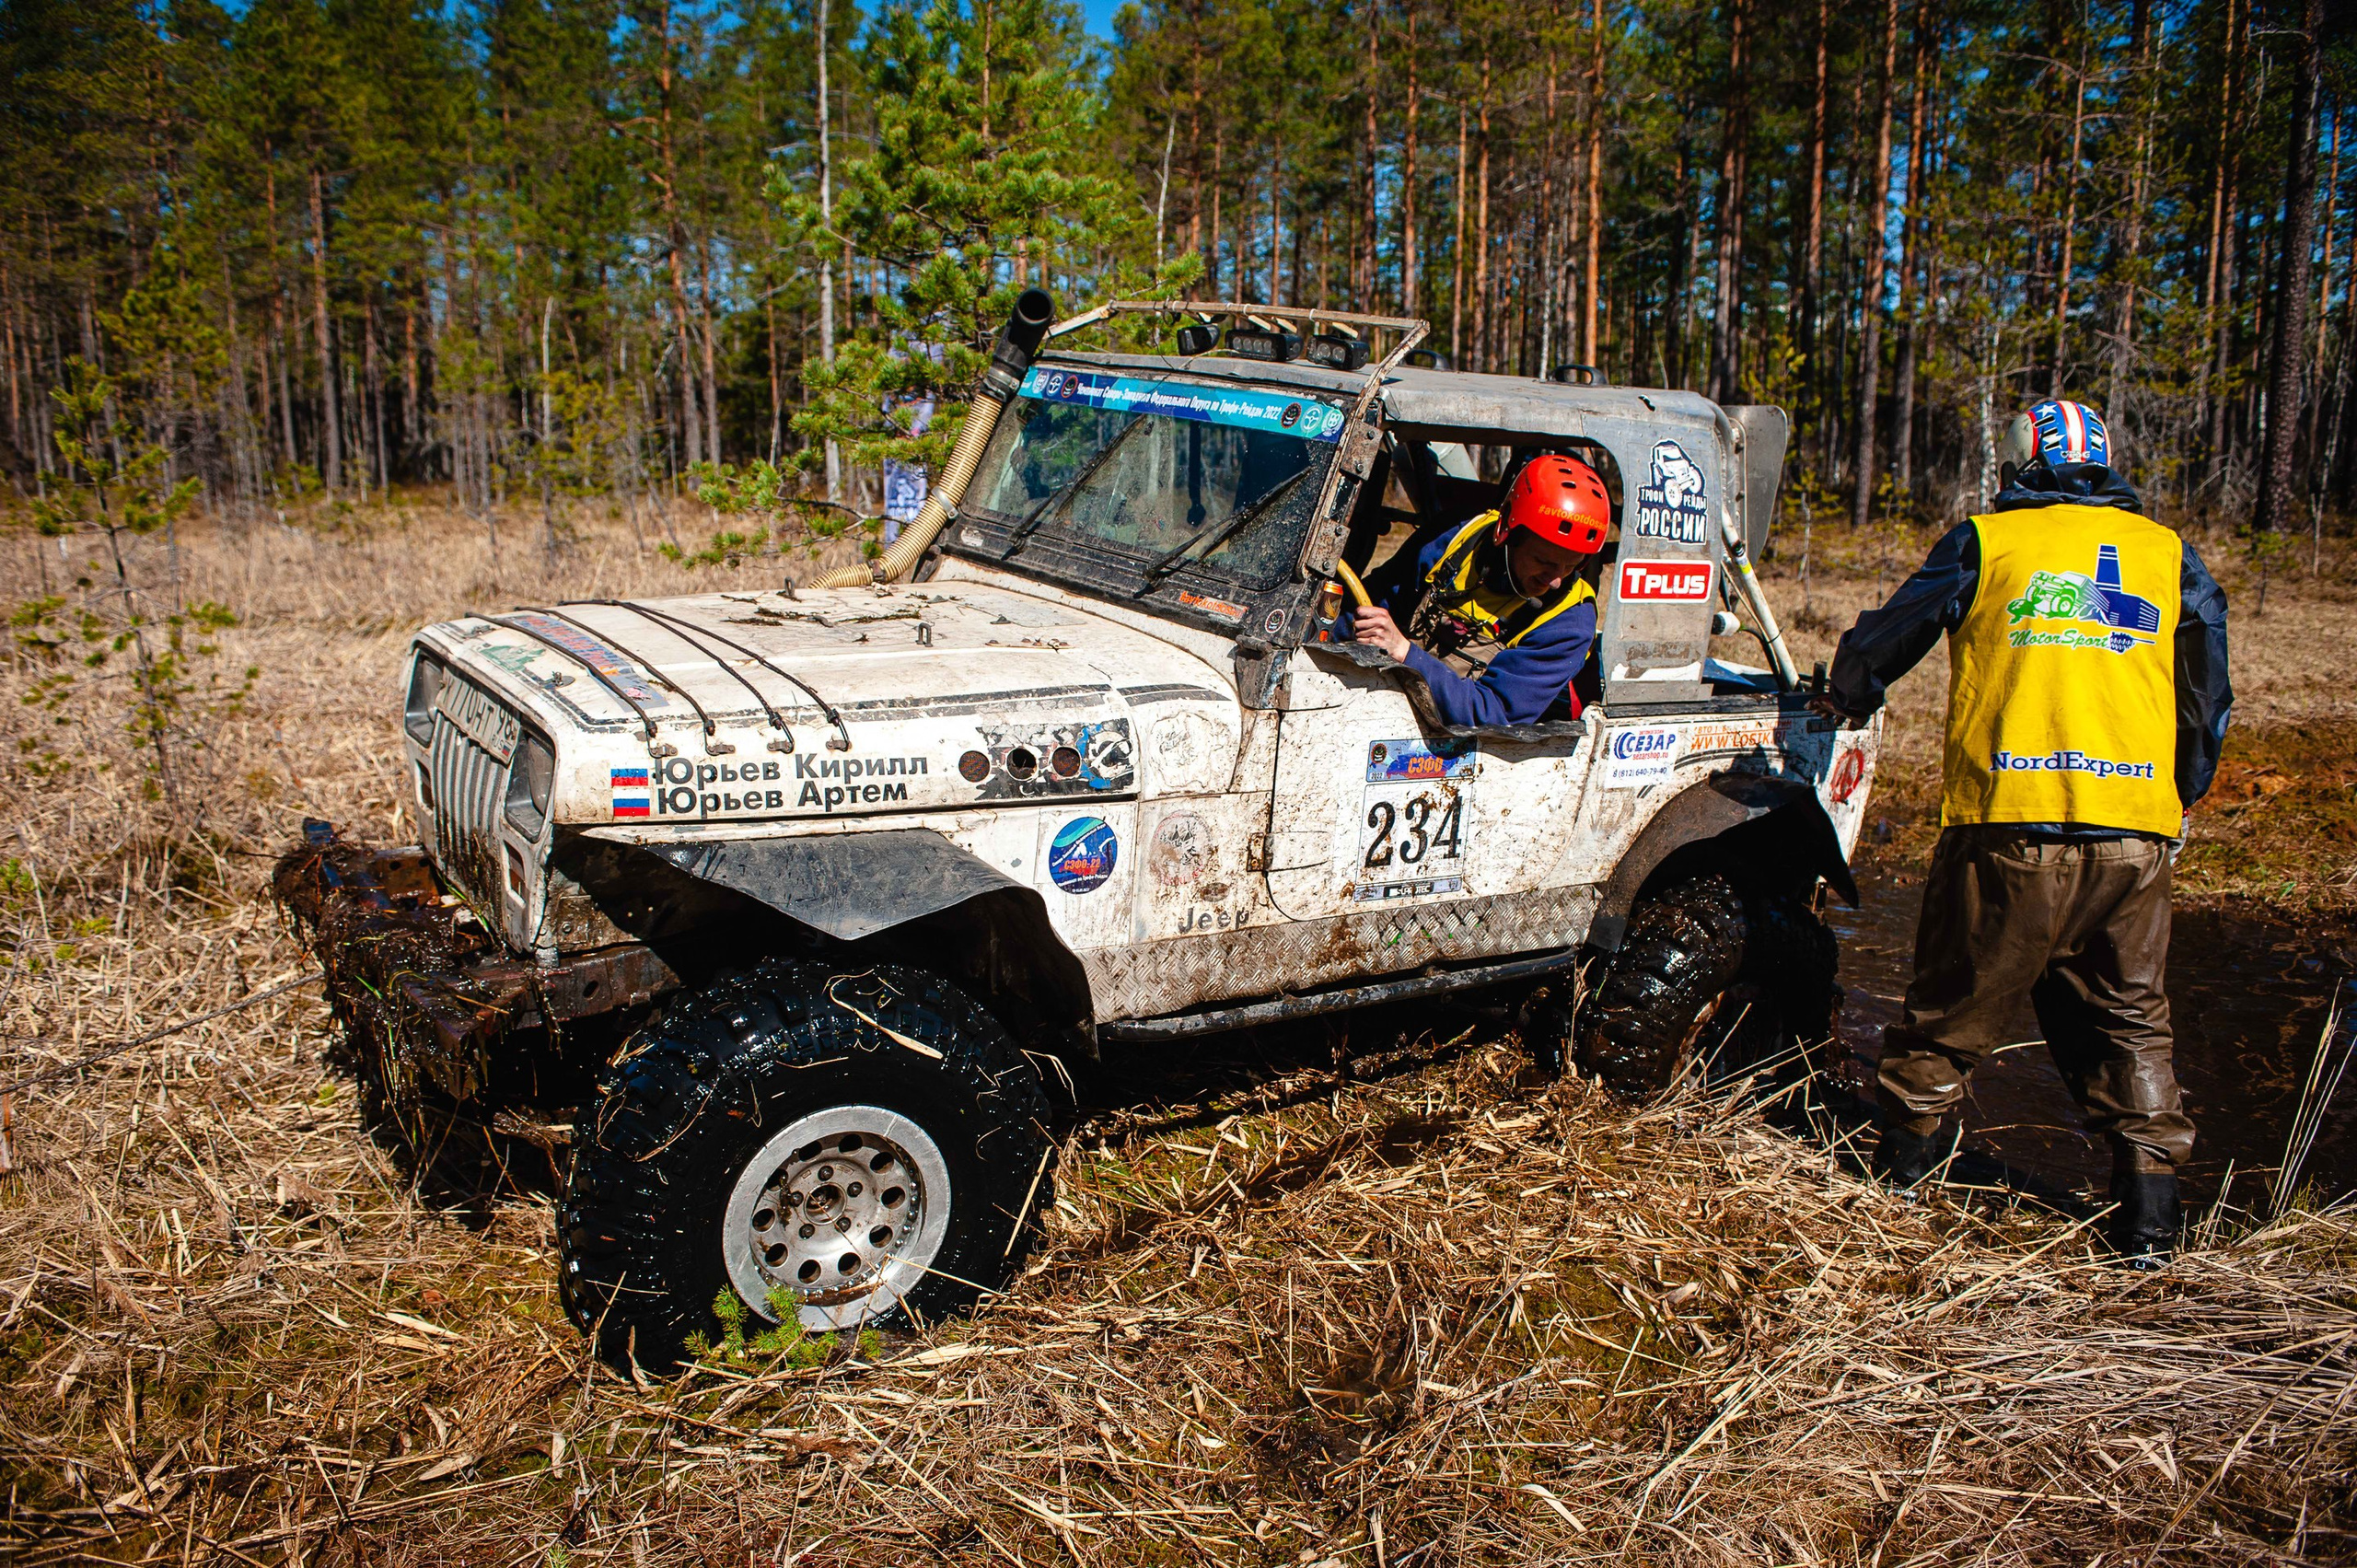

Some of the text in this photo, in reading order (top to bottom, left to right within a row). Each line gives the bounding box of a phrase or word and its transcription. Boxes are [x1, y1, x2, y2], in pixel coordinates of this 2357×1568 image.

[1190, 394, 1211, 412] Округа
[1210, 401, 1220, 412] по
[1219, 399, 1264, 419] Трофи-Рейдам
[1262, 404, 1283, 421] 2022
[1641, 488, 1707, 511] ТРОФИ РЕЙДЫ
[1640, 507, 1706, 542] РОССИИ
[2008, 629, 2109, 649] MotorSport
[1626, 734, 1677, 753] СЕЗАР
[1632, 751, 1669, 761] sezarshop.ru
[655, 752, 929, 790] Юрьев Кирилл
[1407, 755, 1444, 774] СЗФО
[1990, 751, 2154, 779] NordExpert
[657, 780, 909, 819] Юрьев Артем
[1364, 796, 1463, 868] 234
[1063, 857, 1101, 870] СЗФО-22
[1394, 885, 1431, 897] SUPRTEC
[1178, 907, 1249, 934] Jeep
